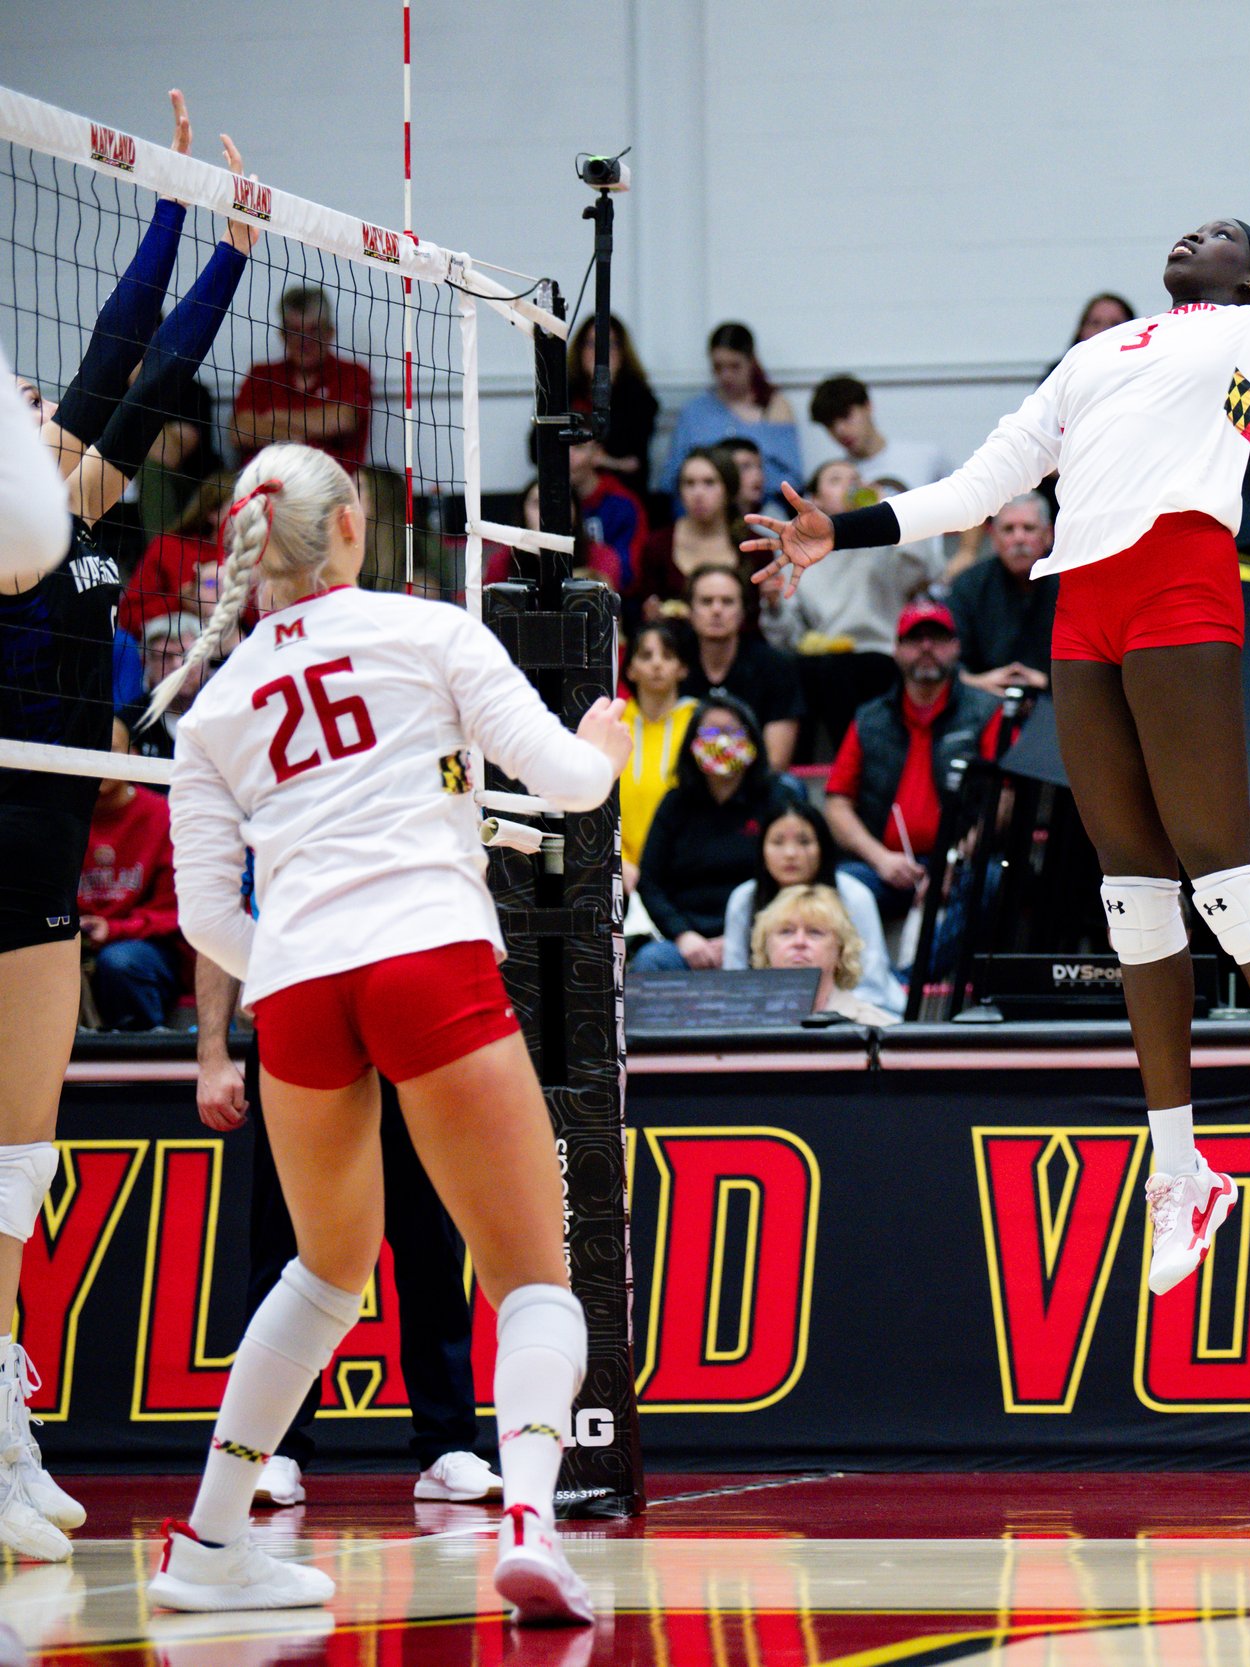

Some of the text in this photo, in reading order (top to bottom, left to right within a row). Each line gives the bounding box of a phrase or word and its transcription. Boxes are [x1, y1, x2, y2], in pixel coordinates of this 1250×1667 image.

[90, 122, 136, 166] MARYLAND
[274, 616, 308, 650] M
[252, 656, 377, 785] 26
[556, 1489, 607, 1500] 556-3198
